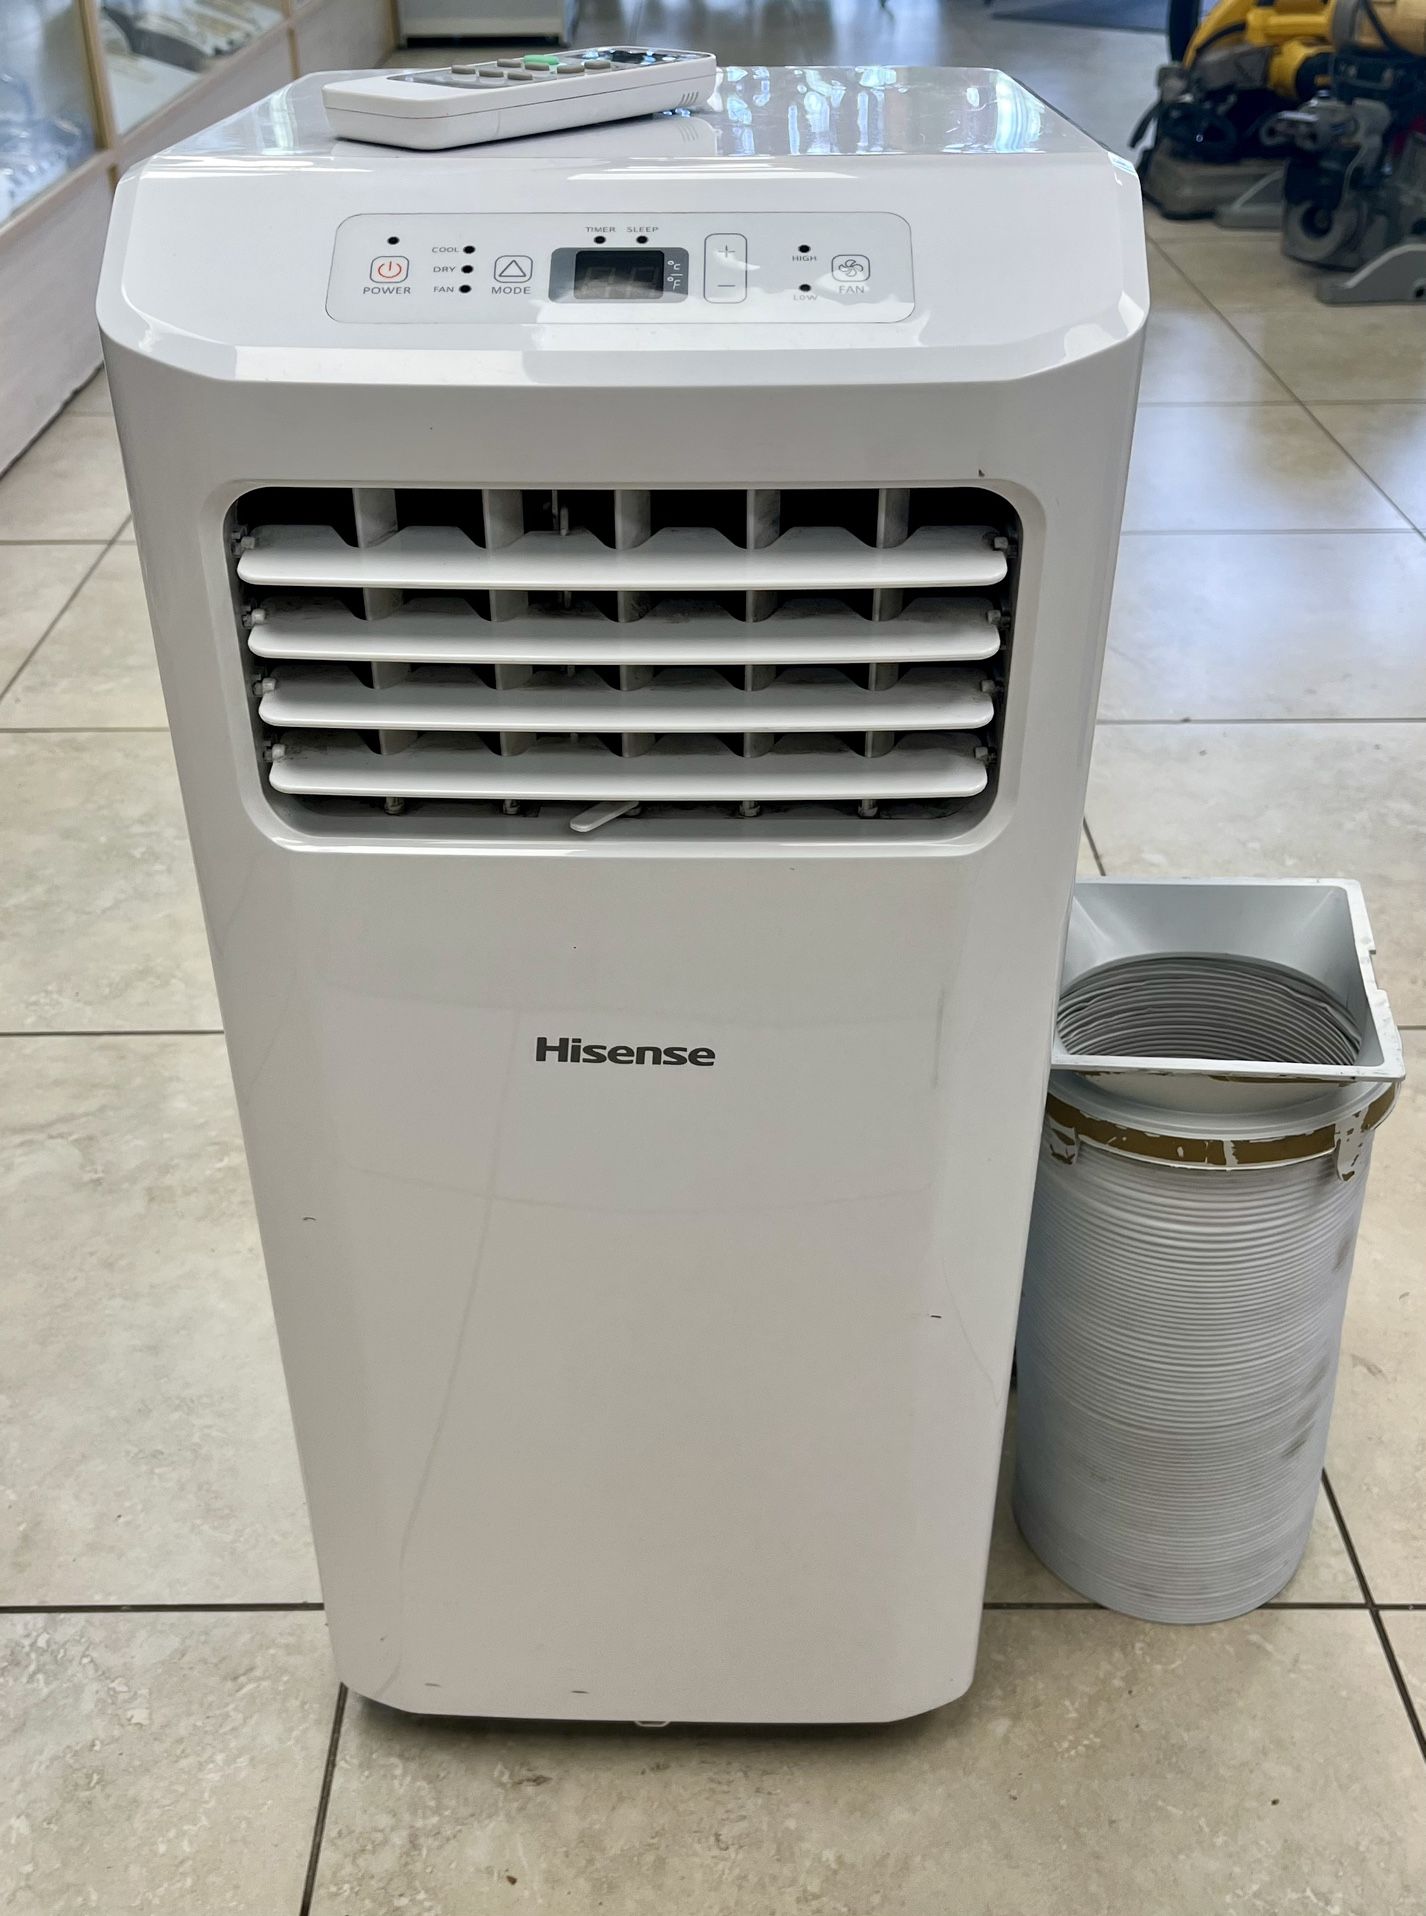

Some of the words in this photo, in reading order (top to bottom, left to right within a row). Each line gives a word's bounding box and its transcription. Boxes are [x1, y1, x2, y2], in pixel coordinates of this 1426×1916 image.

[585, 226, 616, 234] TIMER
[626, 226, 659, 234] SLEEP
[431, 246, 460, 254] COOL
[792, 254, 818, 263] HIGH
[433, 265, 457, 274] DRY
[362, 286, 411, 296] POWER
[433, 285, 455, 294] FAN
[491, 286, 532, 296] MODE
[838, 285, 865, 295] FAN
[535, 1036, 716, 1067] Hisense
